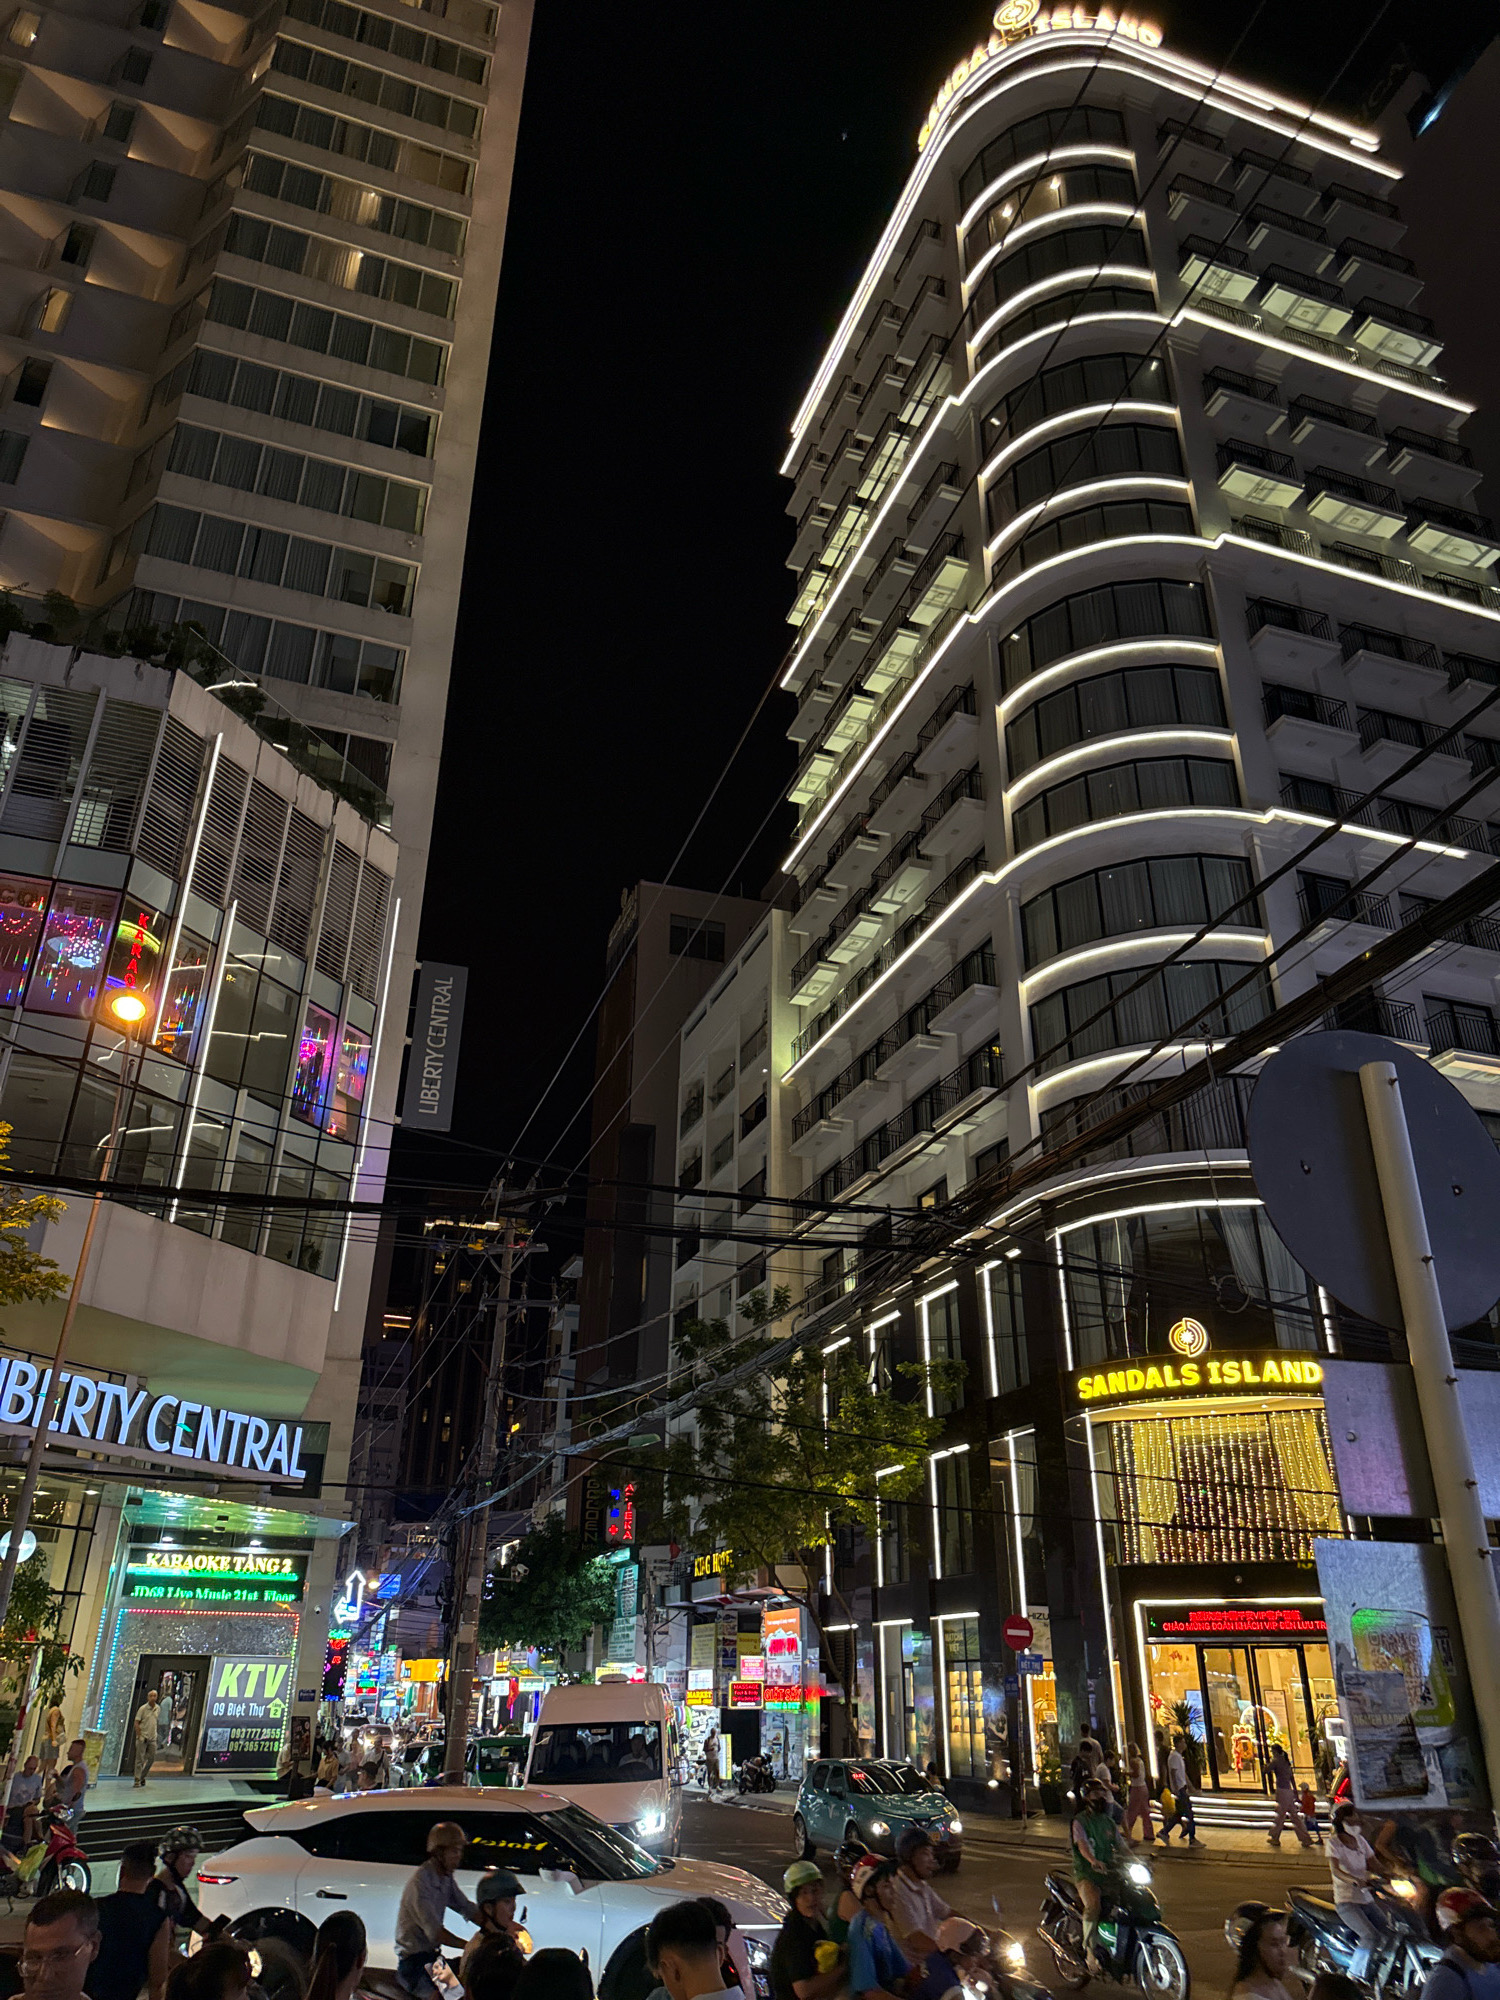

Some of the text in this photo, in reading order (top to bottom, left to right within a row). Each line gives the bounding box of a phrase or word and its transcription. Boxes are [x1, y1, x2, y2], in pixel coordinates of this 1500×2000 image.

[1034, 6, 1165, 48] ISLAND
[418, 976, 453, 1115] LIBERTY CENTRAL
[1078, 1360, 1323, 1399] SANDALS ISLAND
[0, 1357, 306, 1478] IBERTY CENTRAL
[146, 1552, 230, 1571] KARAOKE
[281, 1558, 292, 1573] 2
[167, 1586, 193, 1599] Live
[195, 1588, 232, 1600] Music
[233, 1589, 258, 1601] 21st
[264, 1590, 296, 1602] Floor
[1162, 1620, 1185, 1631] CHÀO
[1265, 1620, 1278, 1630] VIP
[1314, 1620, 1327, 1629] TR
[216, 1663, 288, 1698] KTV
[212, 1702, 266, 1718] 09 Biệt Thự
